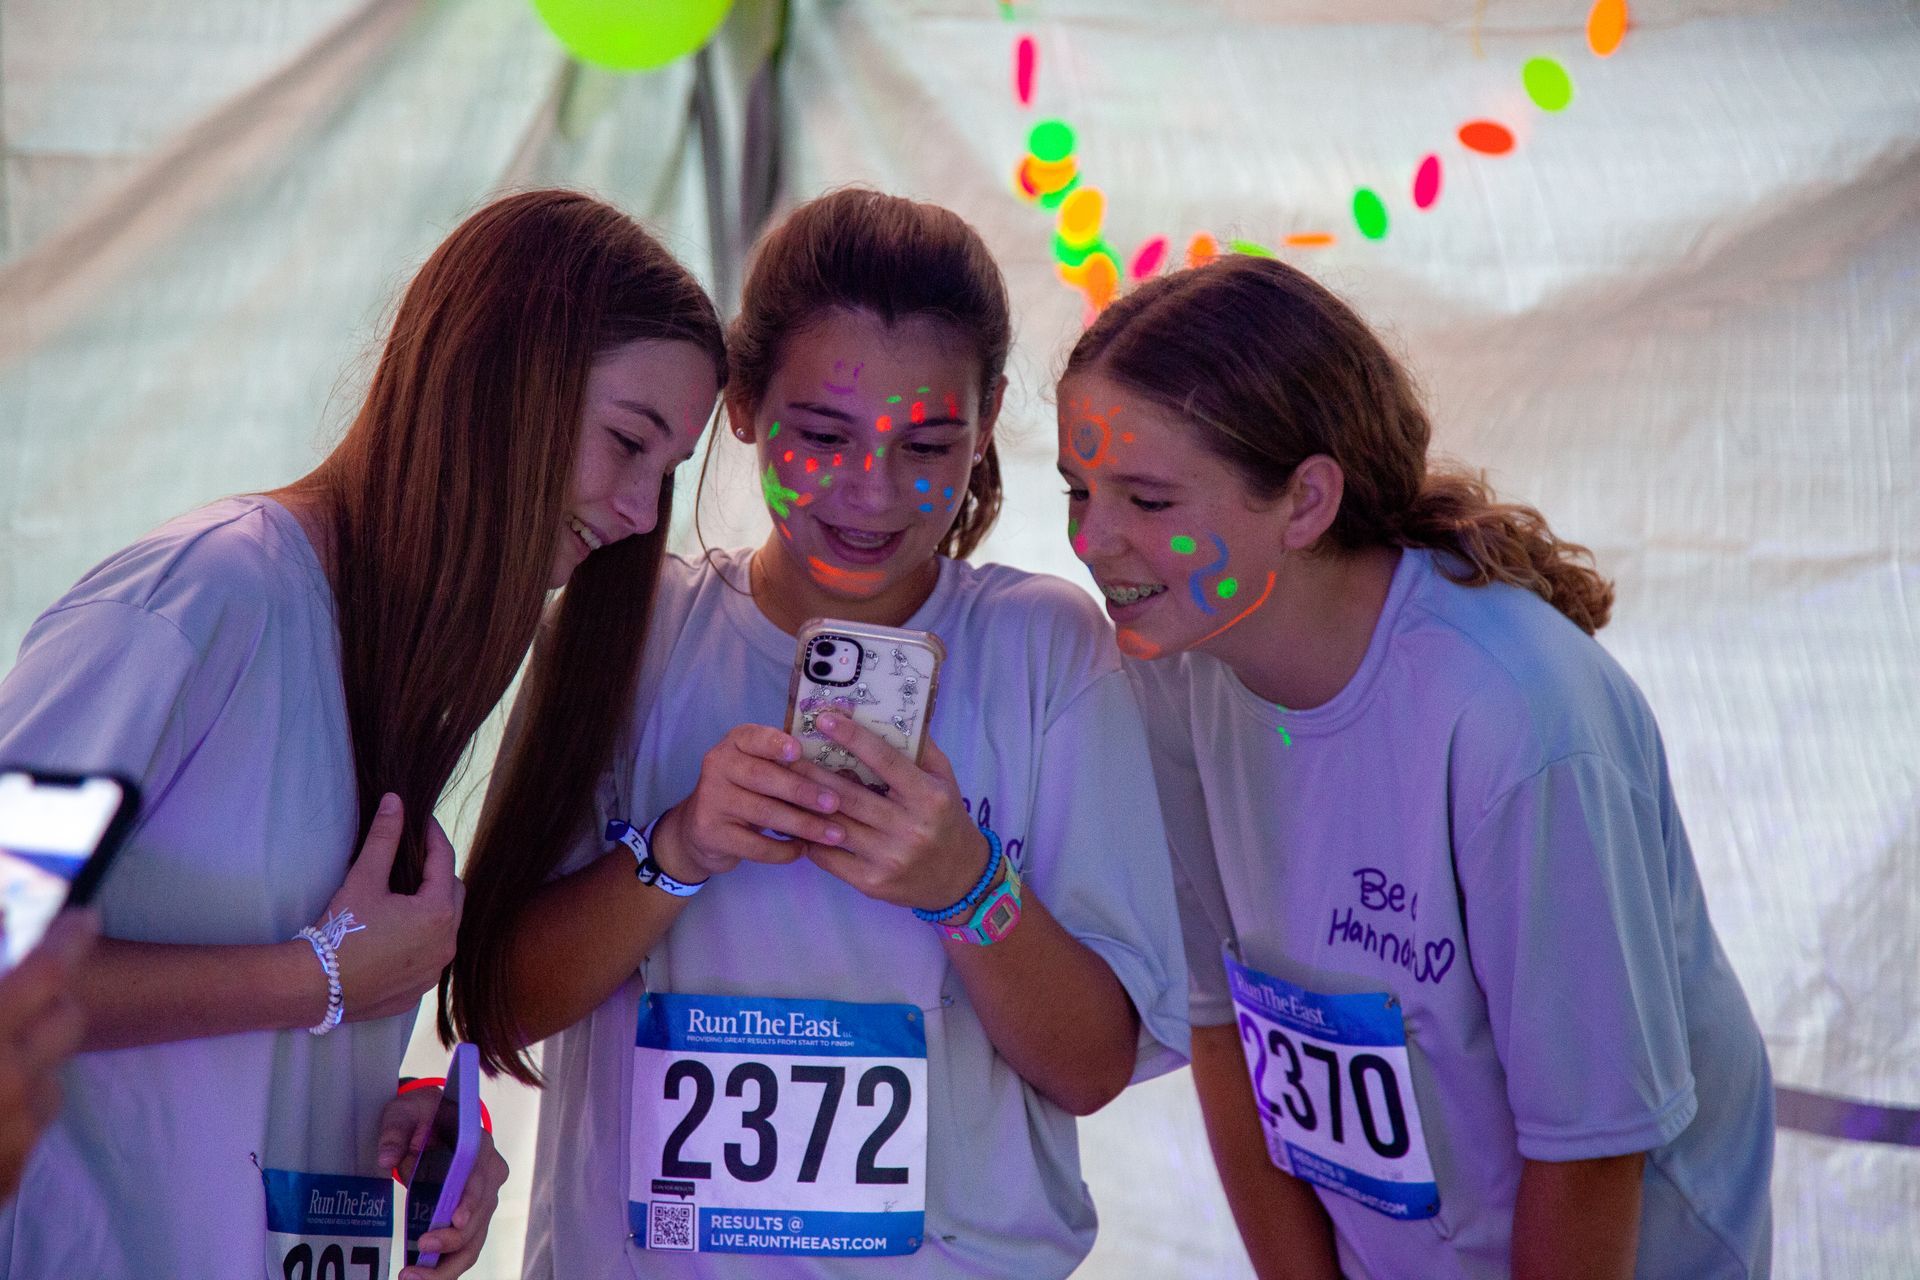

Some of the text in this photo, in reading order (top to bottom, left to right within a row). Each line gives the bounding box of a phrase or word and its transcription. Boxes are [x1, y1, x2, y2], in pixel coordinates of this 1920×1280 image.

[688, 1008, 737, 1034] Run
[739, 1010, 785, 1036] The
[787, 1012, 841, 1038] East
[686, 1035, 722, 1043] PROVIDING
[724, 1036, 746, 1044] GREAT
[1239, 1012, 1409, 1159] 2370
[661, 1059, 911, 1185] 2372
[309, 1189, 335, 1214] Run
[335, 1190, 358, 1216] The
[358, 1192, 386, 1217] East
[711, 1215, 804, 1233] RESULTS @
[711, 1234, 887, 1250] LIVE.RUNTHEEAST.COM
